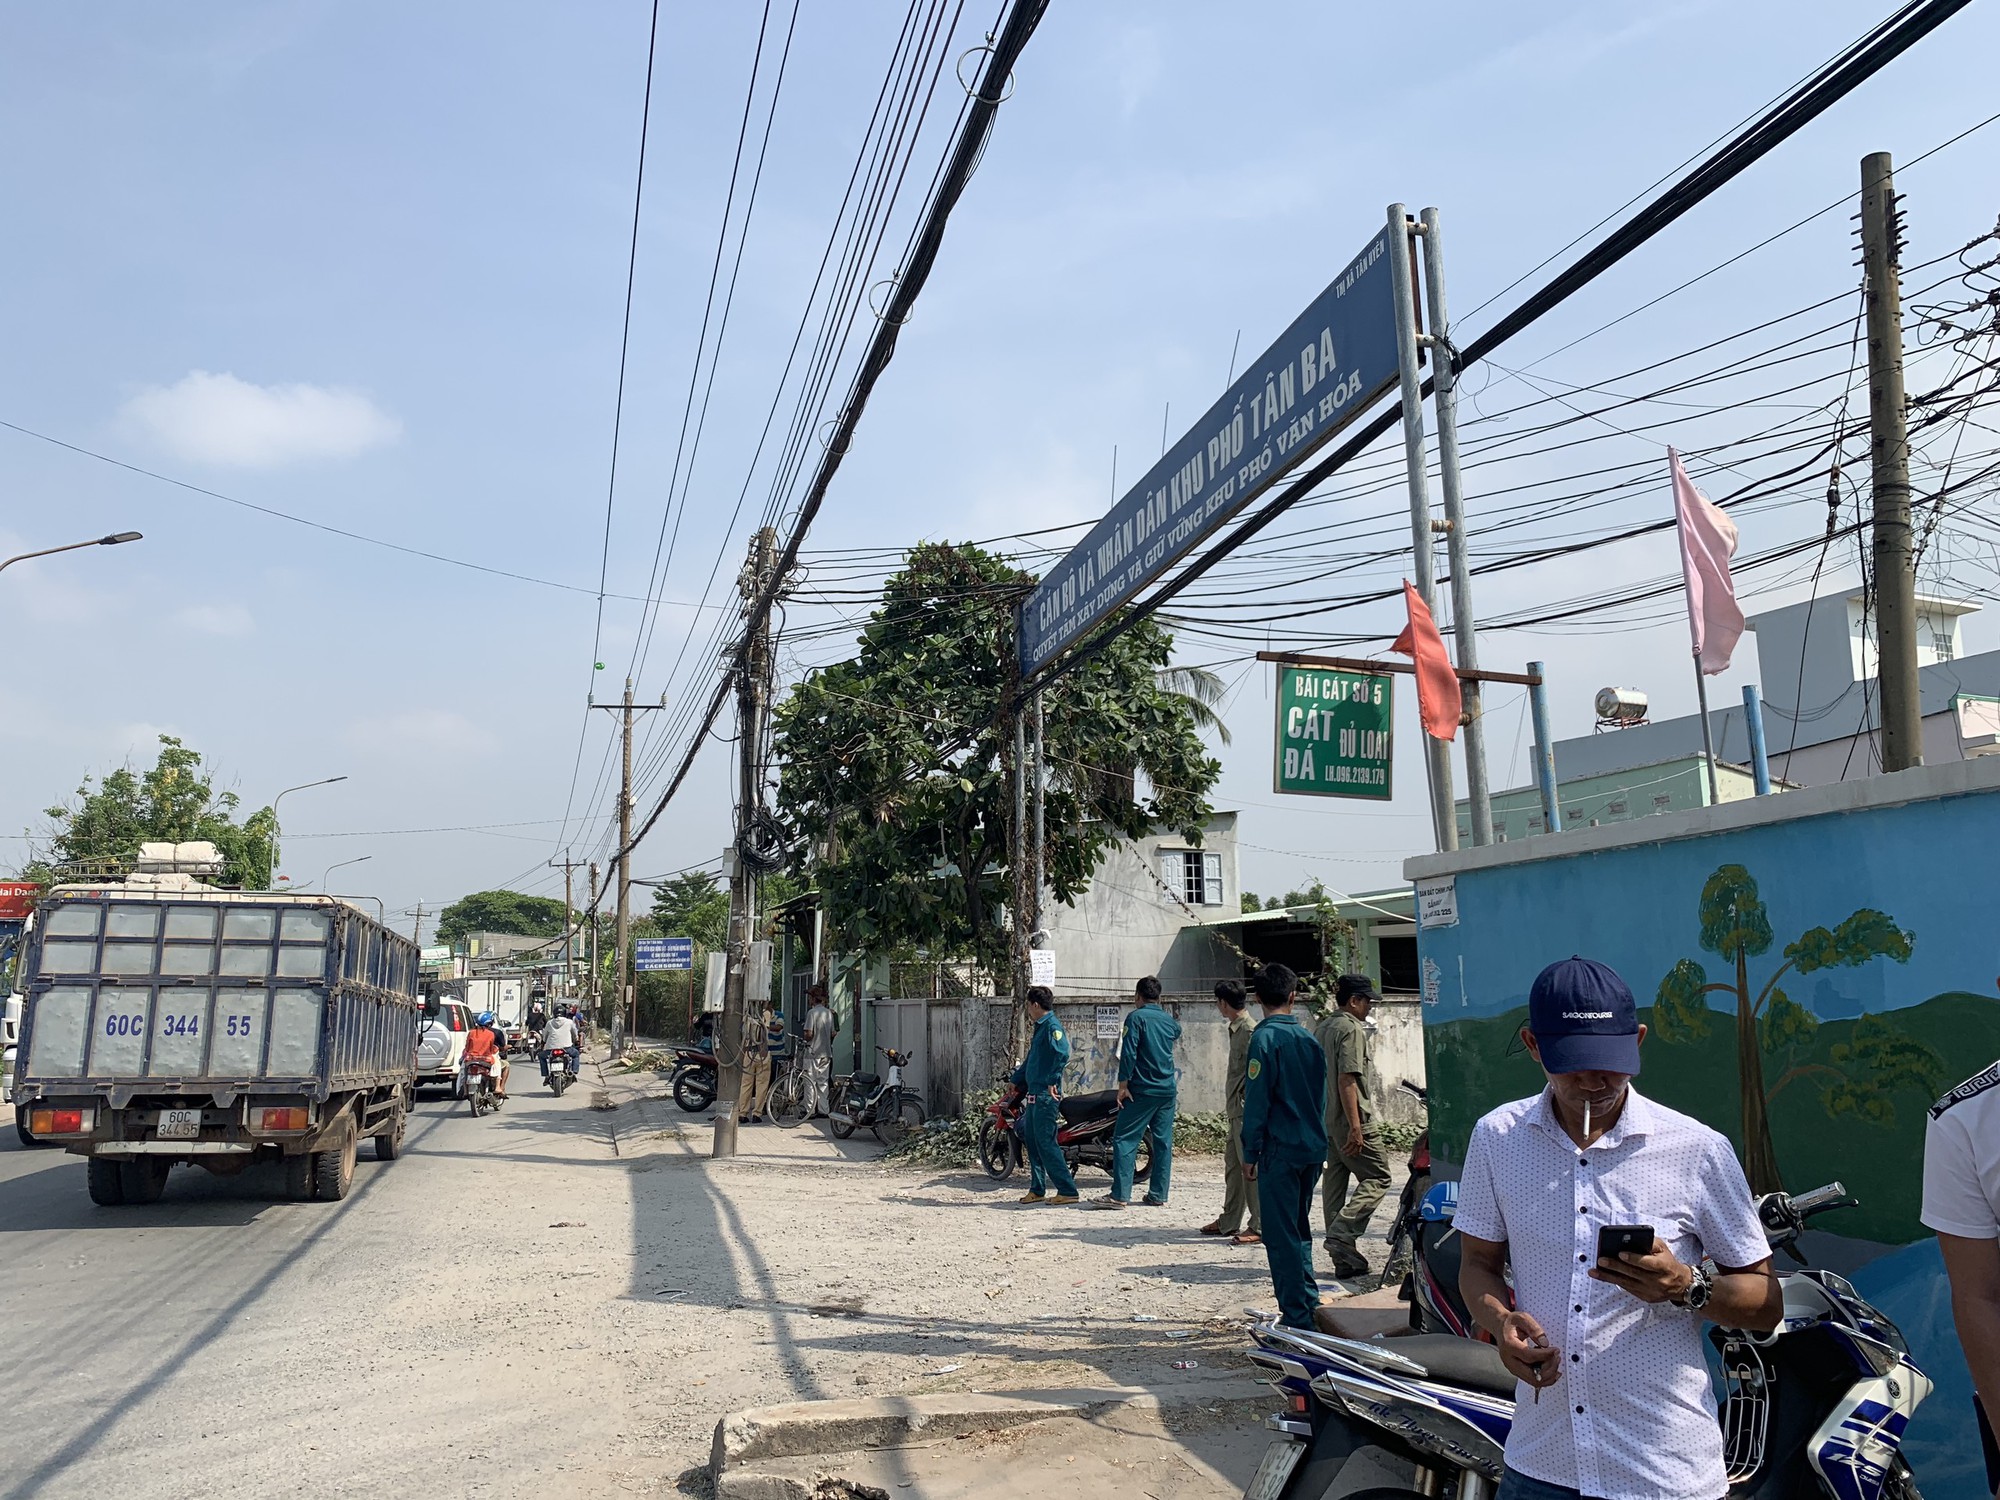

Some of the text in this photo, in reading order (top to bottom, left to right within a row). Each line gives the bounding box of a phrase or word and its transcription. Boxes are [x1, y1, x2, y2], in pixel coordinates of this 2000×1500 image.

[1040, 589, 1060, 632] CÁN
[1062, 567, 1076, 613] BỘ
[1078, 550, 1096, 597] VÀ
[1097, 522, 1133, 581] NHÂN
[1136, 490, 1167, 546] DÂN
[1170, 450, 1204, 515] KHU
[1207, 393, 1244, 481] PHỐ
[1250, 371, 1295, 440] TÂN
[1301, 326, 1337, 396] BA
[1032, 368, 1363, 662] QUYẾT TÂM XÂY DỰNG VÀ GIỮ VỮNG KHU PHỐ VĂN HÓA
[1295, 673, 1383, 706] BÃI CÁT SỐ 5
[1287, 703, 1335, 742] CÁT
[1284, 743, 1316, 781] ĐÁ
[1339, 720, 1388, 766] ĐỦ LOẠI
[105, 1014, 252, 1037] 60C 344 55
[158, 1123, 199, 1137] 344.55
[168, 1111, 192, 1123] 60C
